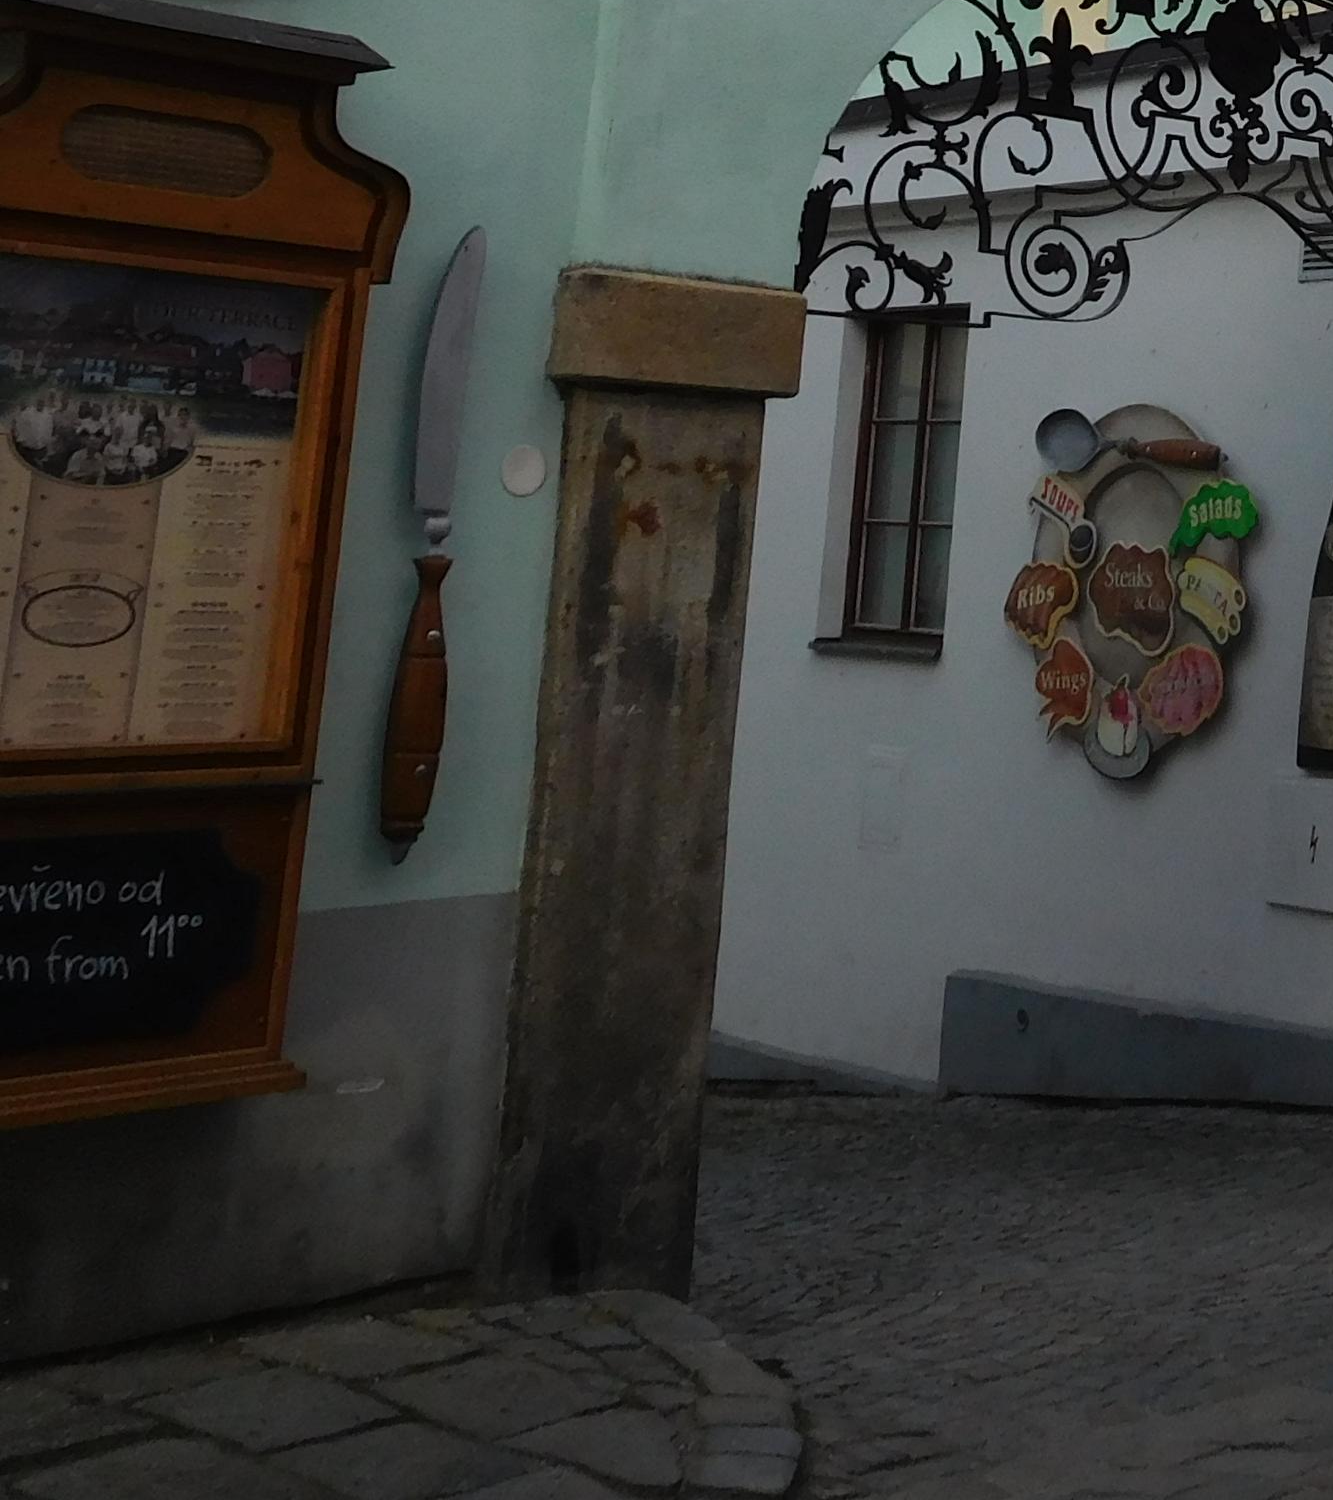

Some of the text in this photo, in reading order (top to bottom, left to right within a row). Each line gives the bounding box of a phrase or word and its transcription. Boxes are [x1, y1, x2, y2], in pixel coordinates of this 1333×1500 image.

[1041, 476, 1080, 523] SOUPS
[1103, 562, 1154, 589] Steaks
[1016, 585, 1055, 610] Ribs
[1185, 574, 1228, 617] PATA
[1040, 669, 1088, 695] Wings
[118, 869, 167, 907] od
[44, 935, 129, 985] from
